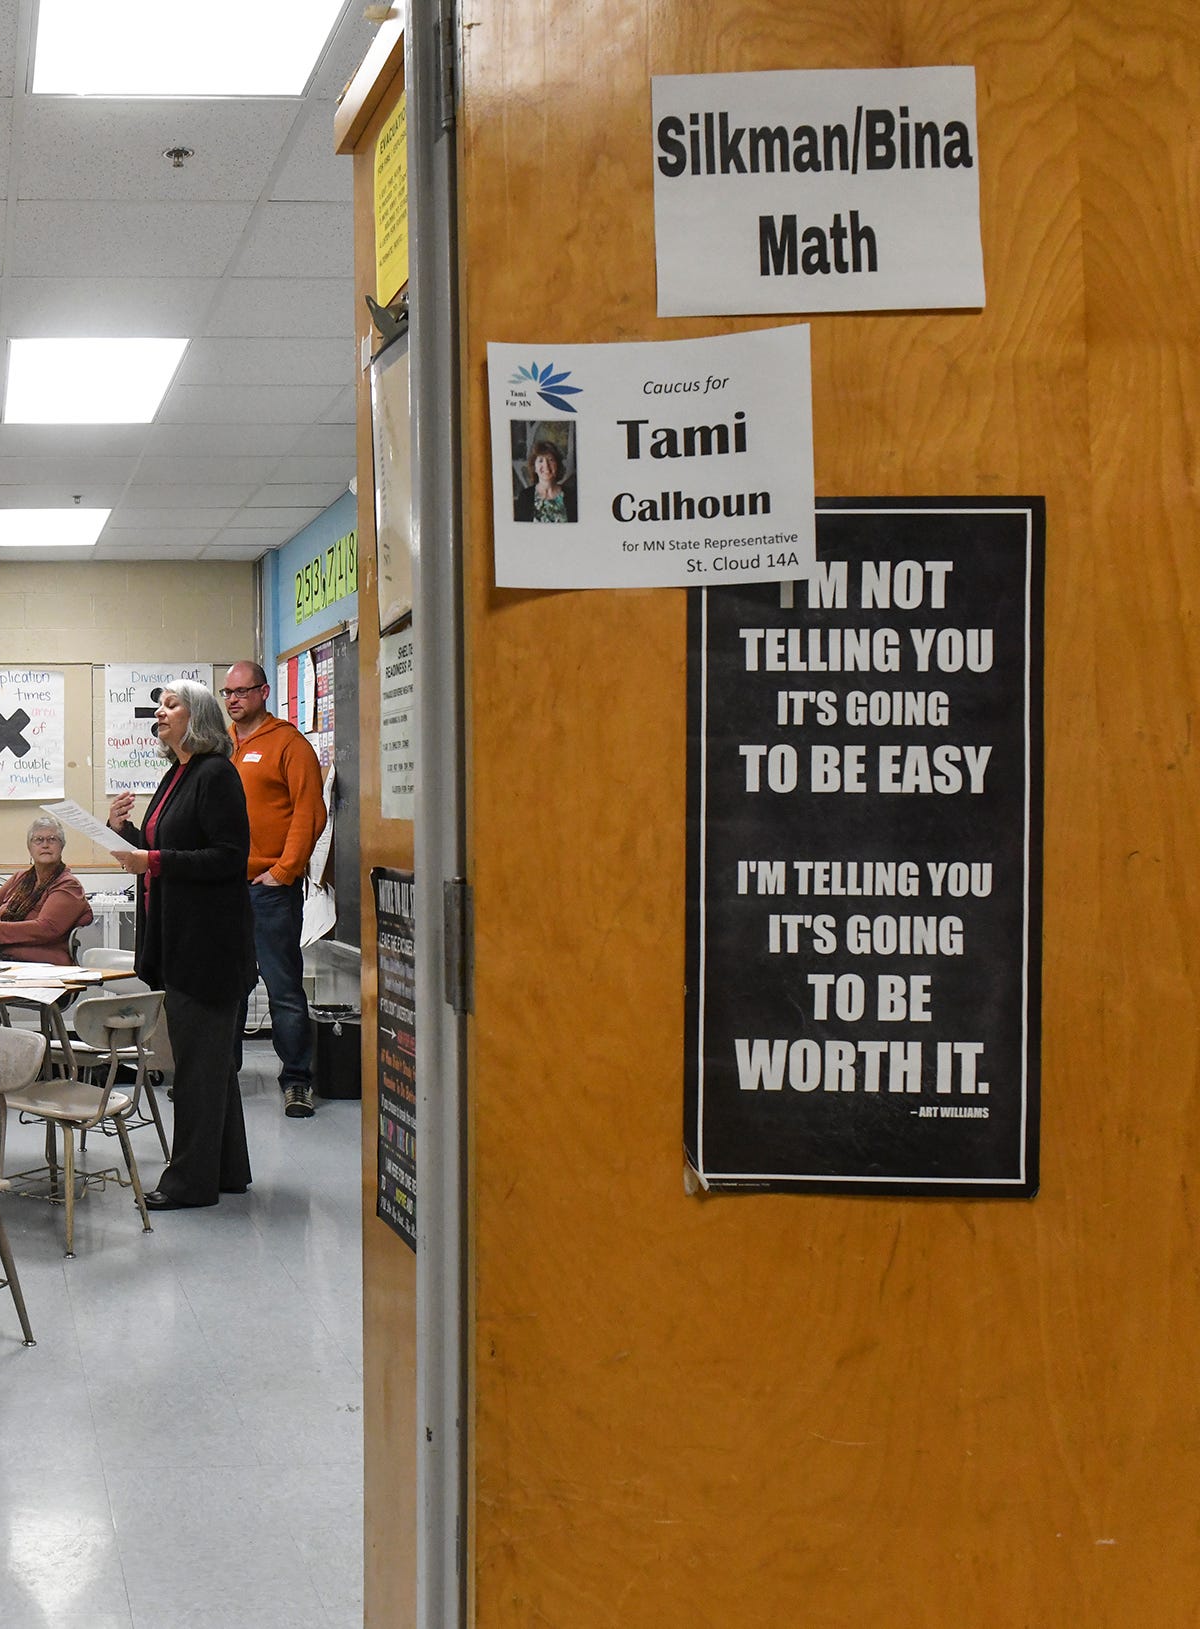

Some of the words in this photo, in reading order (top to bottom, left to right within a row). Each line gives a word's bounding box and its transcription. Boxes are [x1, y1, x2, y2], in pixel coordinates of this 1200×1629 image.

[657, 105, 974, 178] Silkman/Bina
[758, 209, 878, 277] Math
[643, 380, 701, 395] Caucus
[703, 375, 730, 396] for
[616, 411, 747, 460] Tami
[611, 490, 771, 523] Calhoun
[622, 540, 639, 552] for
[643, 540, 665, 552] MN
[668, 540, 700, 551] State
[704, 533, 799, 549] Representative
[686, 558, 708, 573] St.
[712, 554, 761, 572] Cloud
[766, 552, 799, 568] 14A
[780, 560, 848, 609] IM
[860, 559, 954, 610] NOT
[739, 627, 900, 673] TELLING
[909, 627, 994, 673] YOU
[131, 671, 175, 684] Division
[180, 669, 201, 680] cut
[13, 687, 51, 701] times
[109, 686, 136, 703] half
[777, 690, 838, 726] IT'S
[845, 690, 949, 727] GOING
[32, 721, 47, 735] of
[107, 734, 134, 749] equal
[13, 757, 51, 770] double
[129, 748, 158, 761] divid
[144, 760, 170, 770] equa
[738, 743, 798, 794] TO
[810, 744, 867, 793] BE
[878, 744, 993, 795] EASY
[9, 773, 54, 787] multiple
[109, 777, 132, 789] how
[737, 860, 786, 895] I'M
[793, 861, 920, 897] TELLING
[926, 861, 993, 898] YOU
[768, 914, 837, 955] IT'S
[846, 914, 964, 956] GOING
[807, 973, 865, 1022] TO
[877, 974, 932, 1022] BE
[734, 1038, 922, 1093] WORTH
[936, 1041, 990, 1094] IT.
[940, 1106, 990, 1119] WILLIAMS
